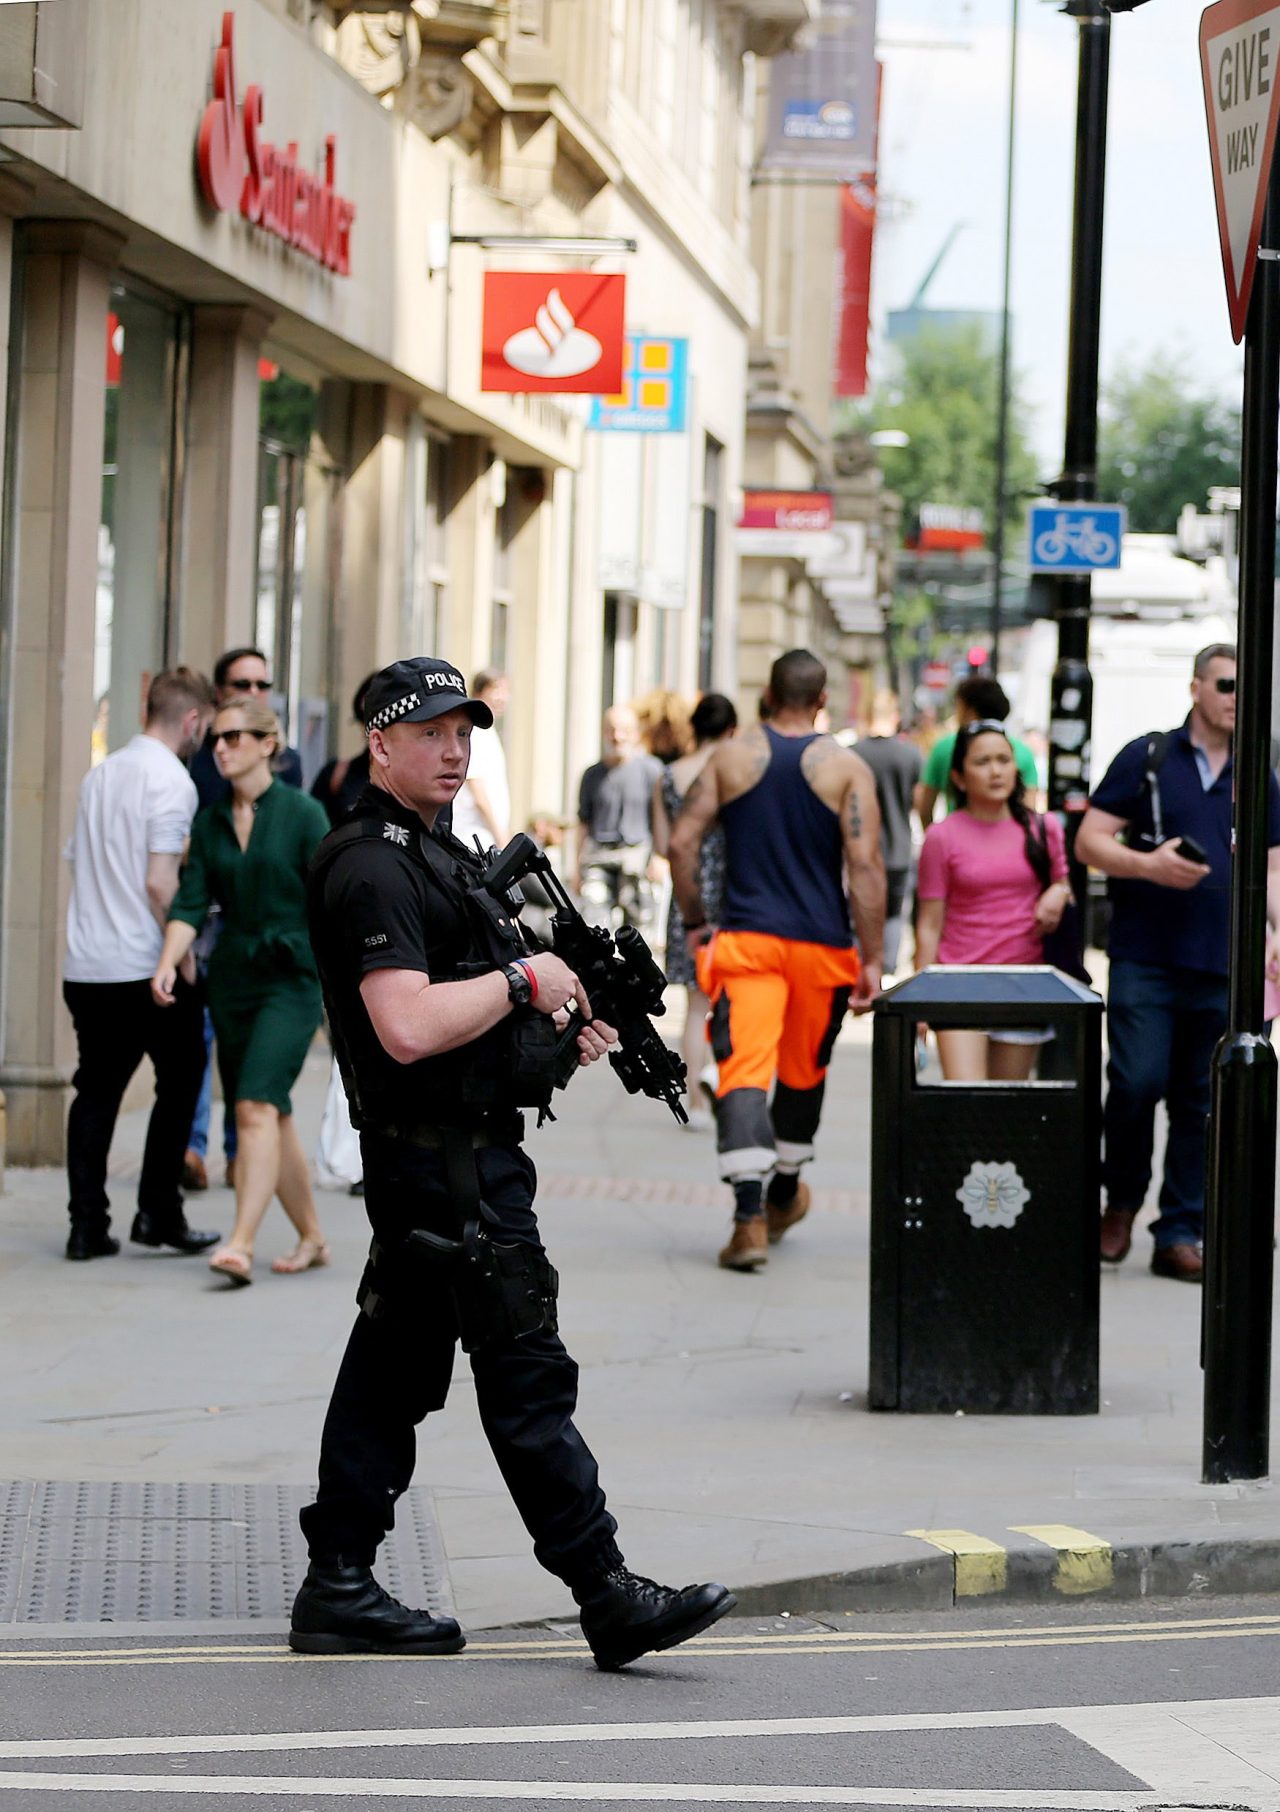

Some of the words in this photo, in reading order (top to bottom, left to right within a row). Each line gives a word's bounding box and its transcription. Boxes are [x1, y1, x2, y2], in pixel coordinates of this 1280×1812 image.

[1218, 28, 1270, 112] GIVE
[1227, 122, 1259, 175] WAY
[240, 83, 357, 277] Santander
[425, 672, 464, 694] POLICE
[364, 933, 388, 947] 5551
